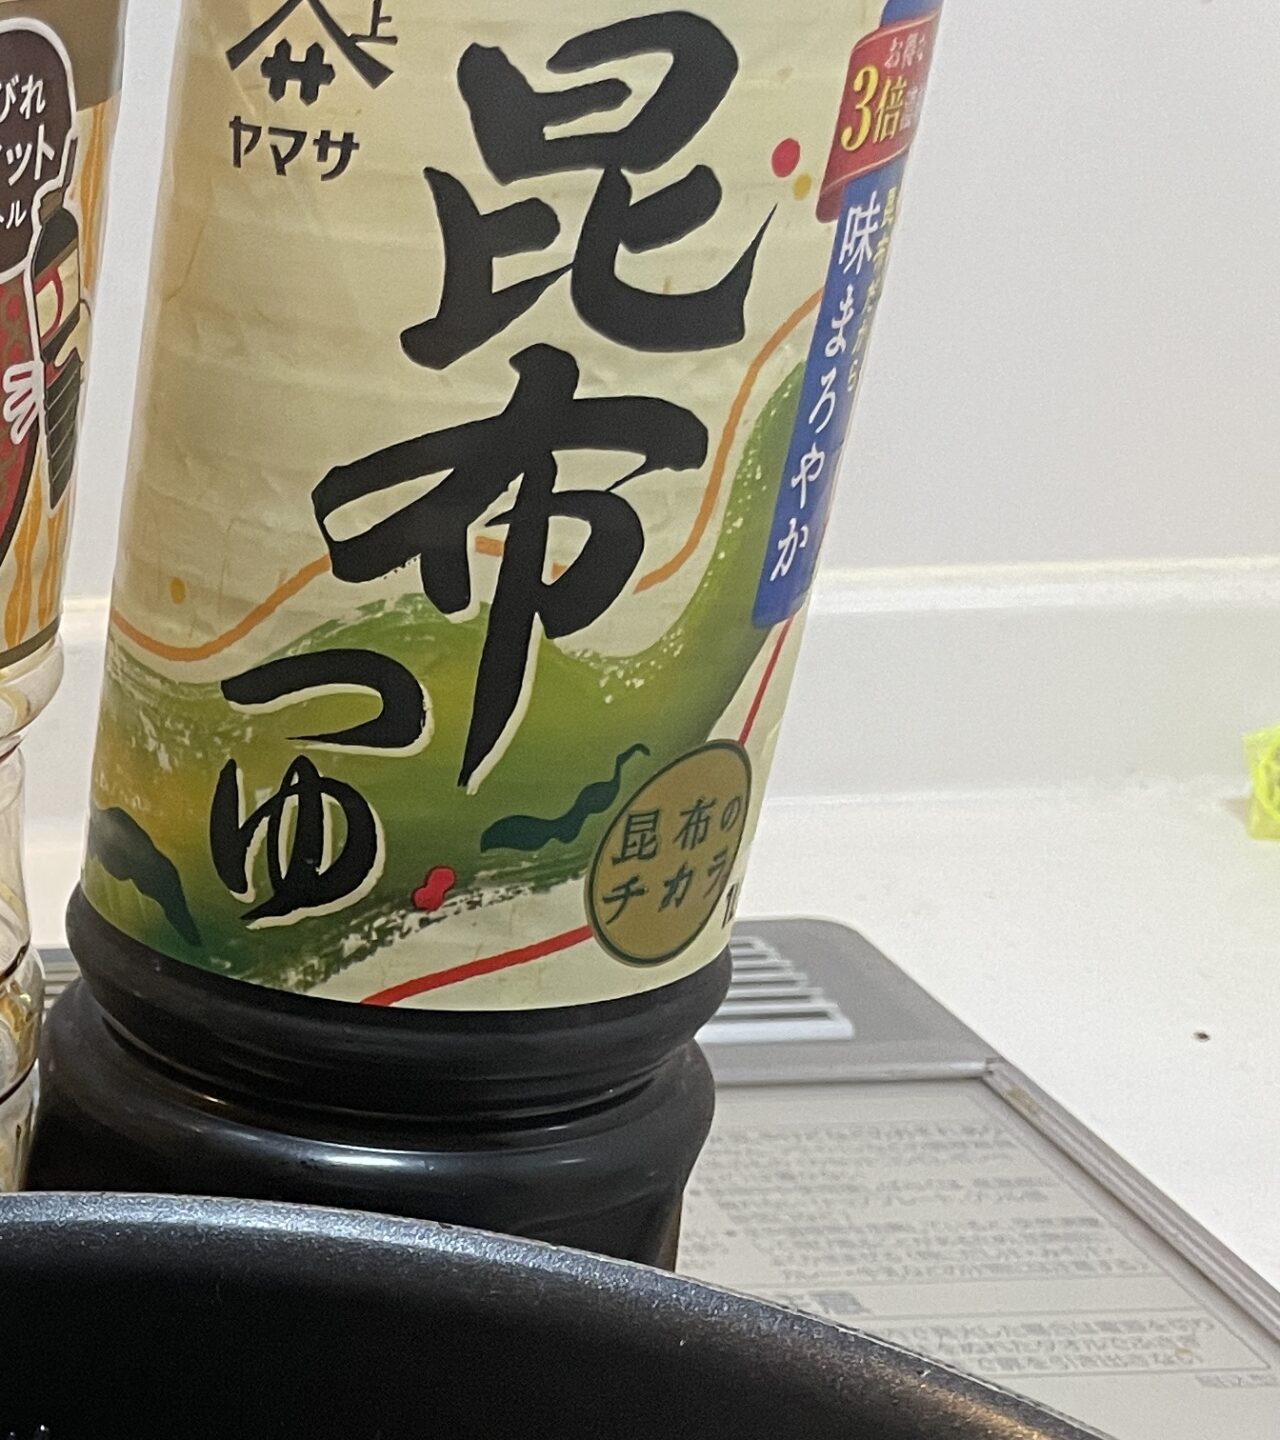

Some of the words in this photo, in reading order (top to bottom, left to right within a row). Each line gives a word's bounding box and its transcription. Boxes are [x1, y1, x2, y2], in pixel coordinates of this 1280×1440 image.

[228, 115, 360, 181] ヤマサ
[770, 190, 880, 581] 味まろやか
[211, 649, 427, 925] つゆ
[612, 795, 743, 866] 昆布の
[602, 848, 730, 926] チカラ
